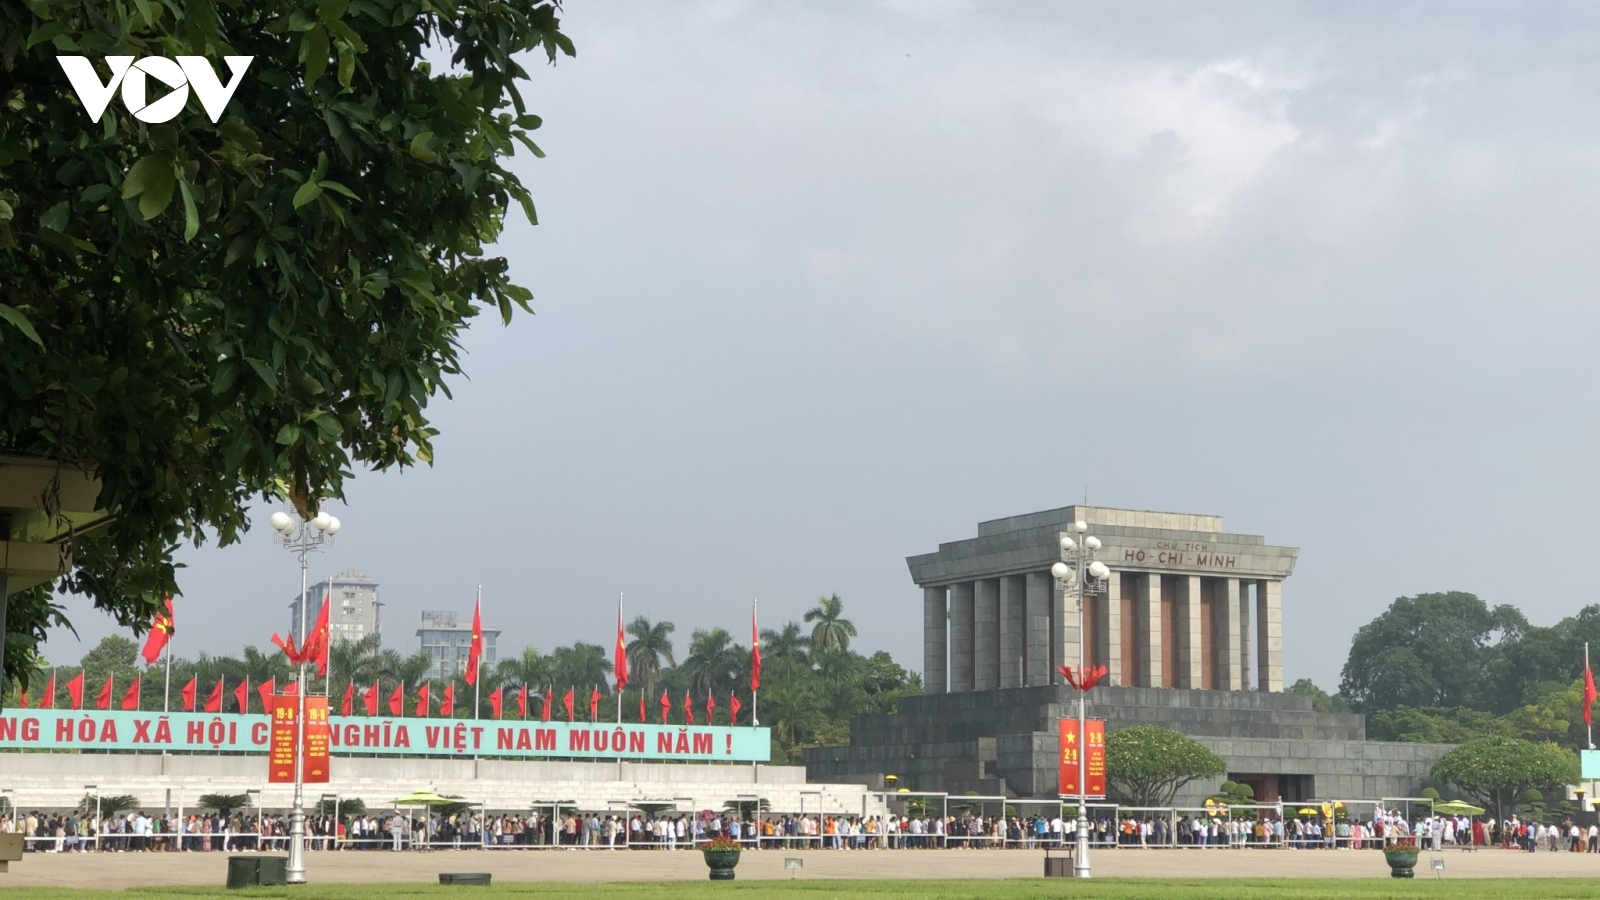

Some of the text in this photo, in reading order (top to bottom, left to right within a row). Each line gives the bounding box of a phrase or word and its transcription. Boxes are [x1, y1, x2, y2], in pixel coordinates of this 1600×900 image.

[276, 707, 293, 720] 19-8
[55, 713, 118, 743] HÒA
[132, 715, 172, 744] XÃ
[186, 716, 238, 749] HỘI
[328, 720, 411, 748] NGHĨA
[425, 722, 485, 753] VIỆT
[497, 728, 557, 751] NAM
[569, 726, 645, 753] MUÔN
[657, 728, 713, 754] NĂM
